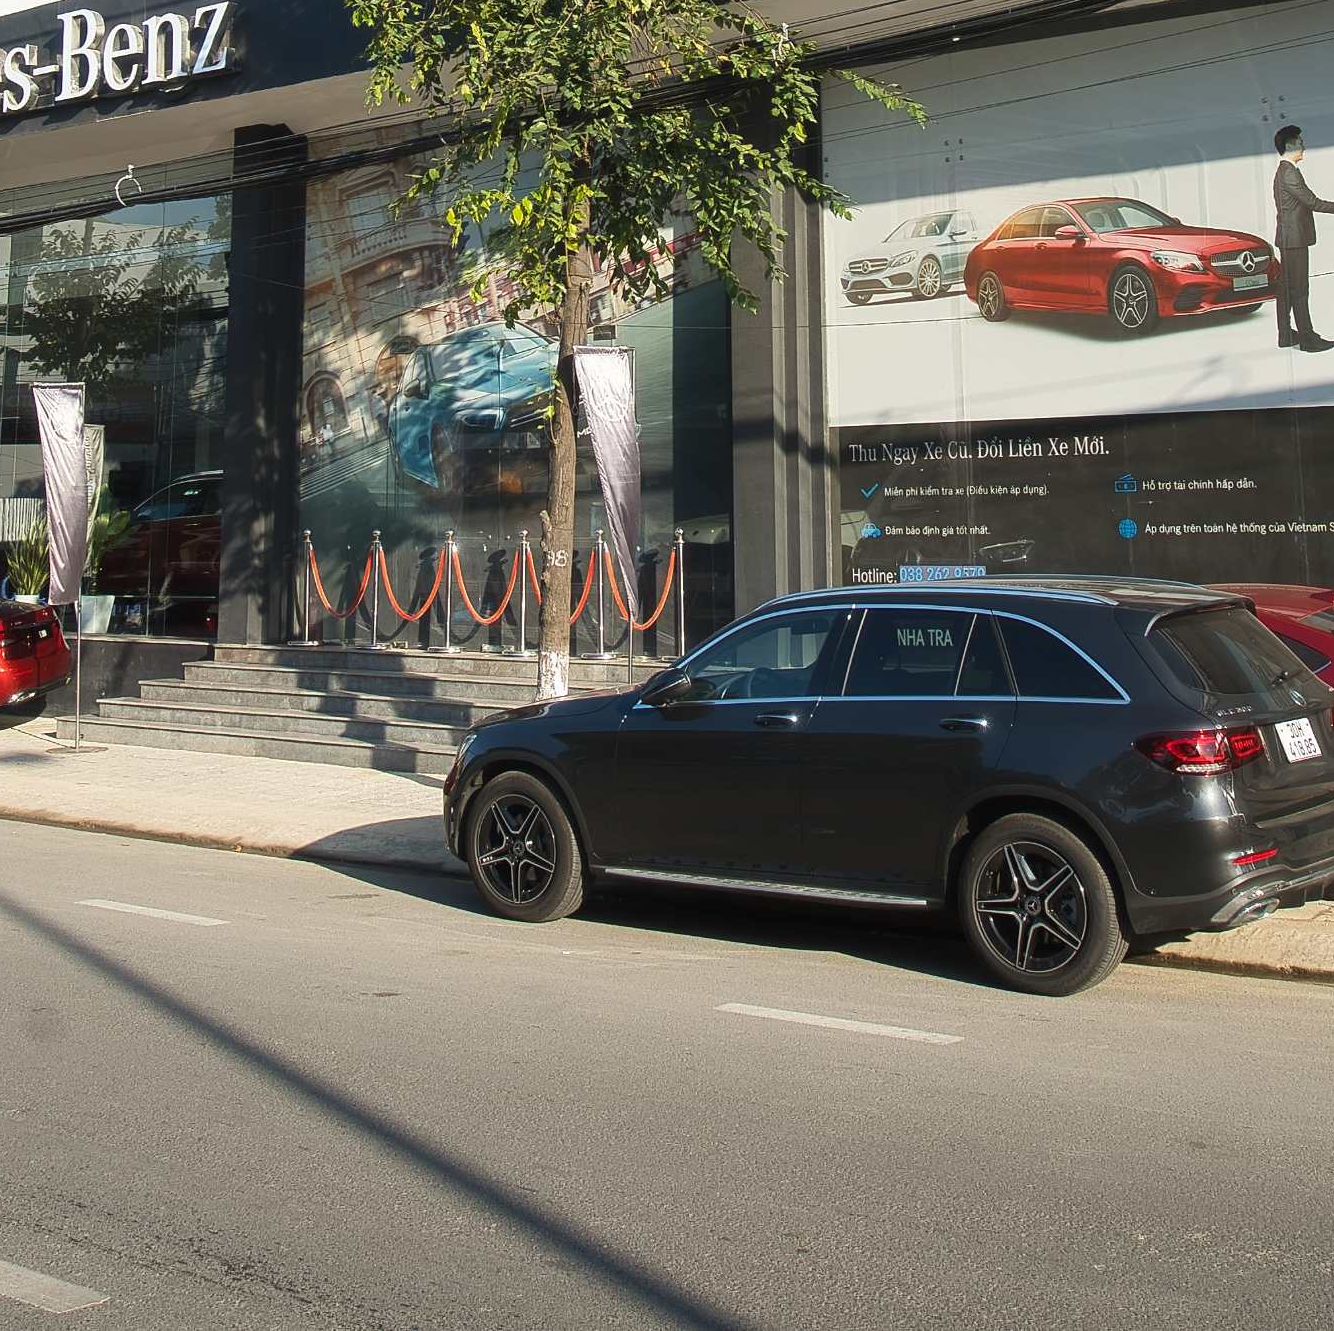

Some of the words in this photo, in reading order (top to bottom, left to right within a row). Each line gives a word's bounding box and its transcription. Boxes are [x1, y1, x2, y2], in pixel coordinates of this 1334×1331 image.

[849, 443, 877, 462] Thu
[881, 443, 918, 466] Ngay
[924, 441, 943, 460] Xe
[977, 435, 1004, 458] Đổi
[1047, 436, 1069, 456] Xe
[1074, 435, 1110, 455] Mới.
[941, 485, 954, 496] tra
[955, 487, 964, 496] xe
[1159, 522, 1181, 536] dụng
[1183, 522, 1201, 533] trên
[1203, 522, 1224, 533] toàn
[1226, 521, 1238, 534] hệ
[1239, 520, 1267, 534] thống
[1287, 521, 1327, 532] Vietnam
[852, 568, 898, 584] Hotline:
[899, 567, 923, 582] 038
[897, 628, 925, 647] NHA
[927, 628, 954, 647] TRA
